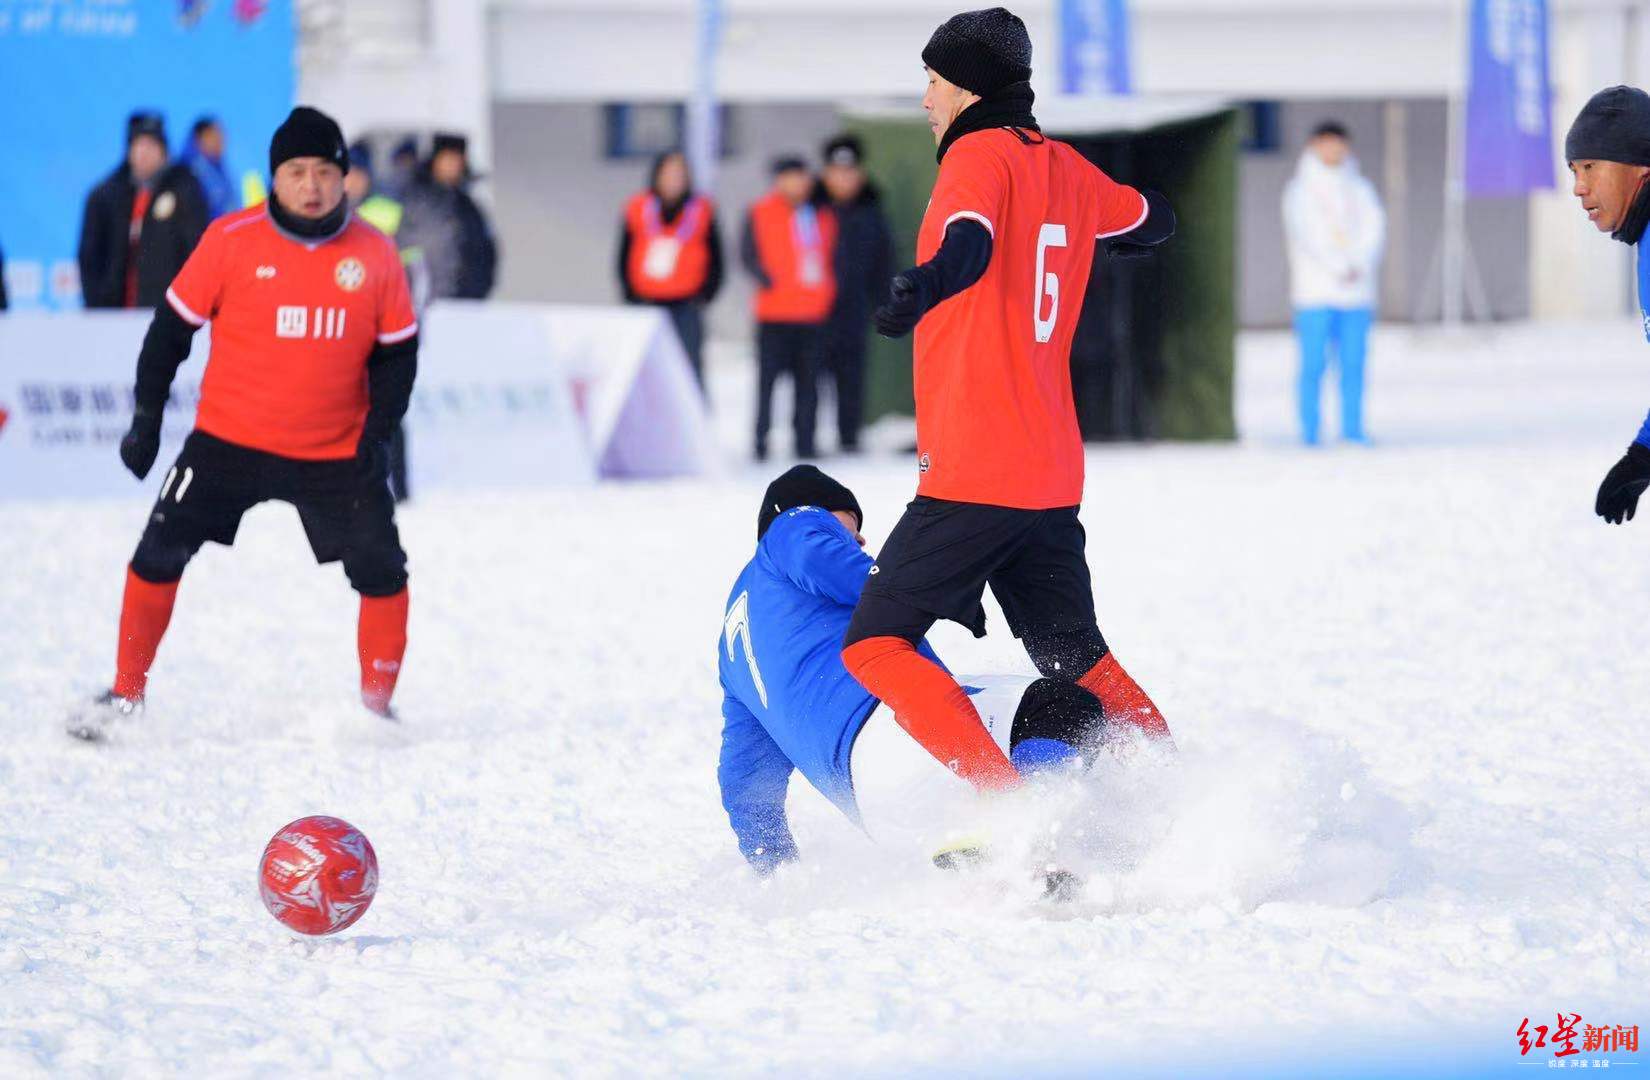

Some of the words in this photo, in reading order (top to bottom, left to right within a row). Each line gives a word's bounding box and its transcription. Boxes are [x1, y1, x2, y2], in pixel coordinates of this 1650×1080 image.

[275, 305, 346, 340] 四川
[1033, 223, 1067, 343] 6
[160, 465, 194, 504] 11
[725, 590, 768, 710] 7
